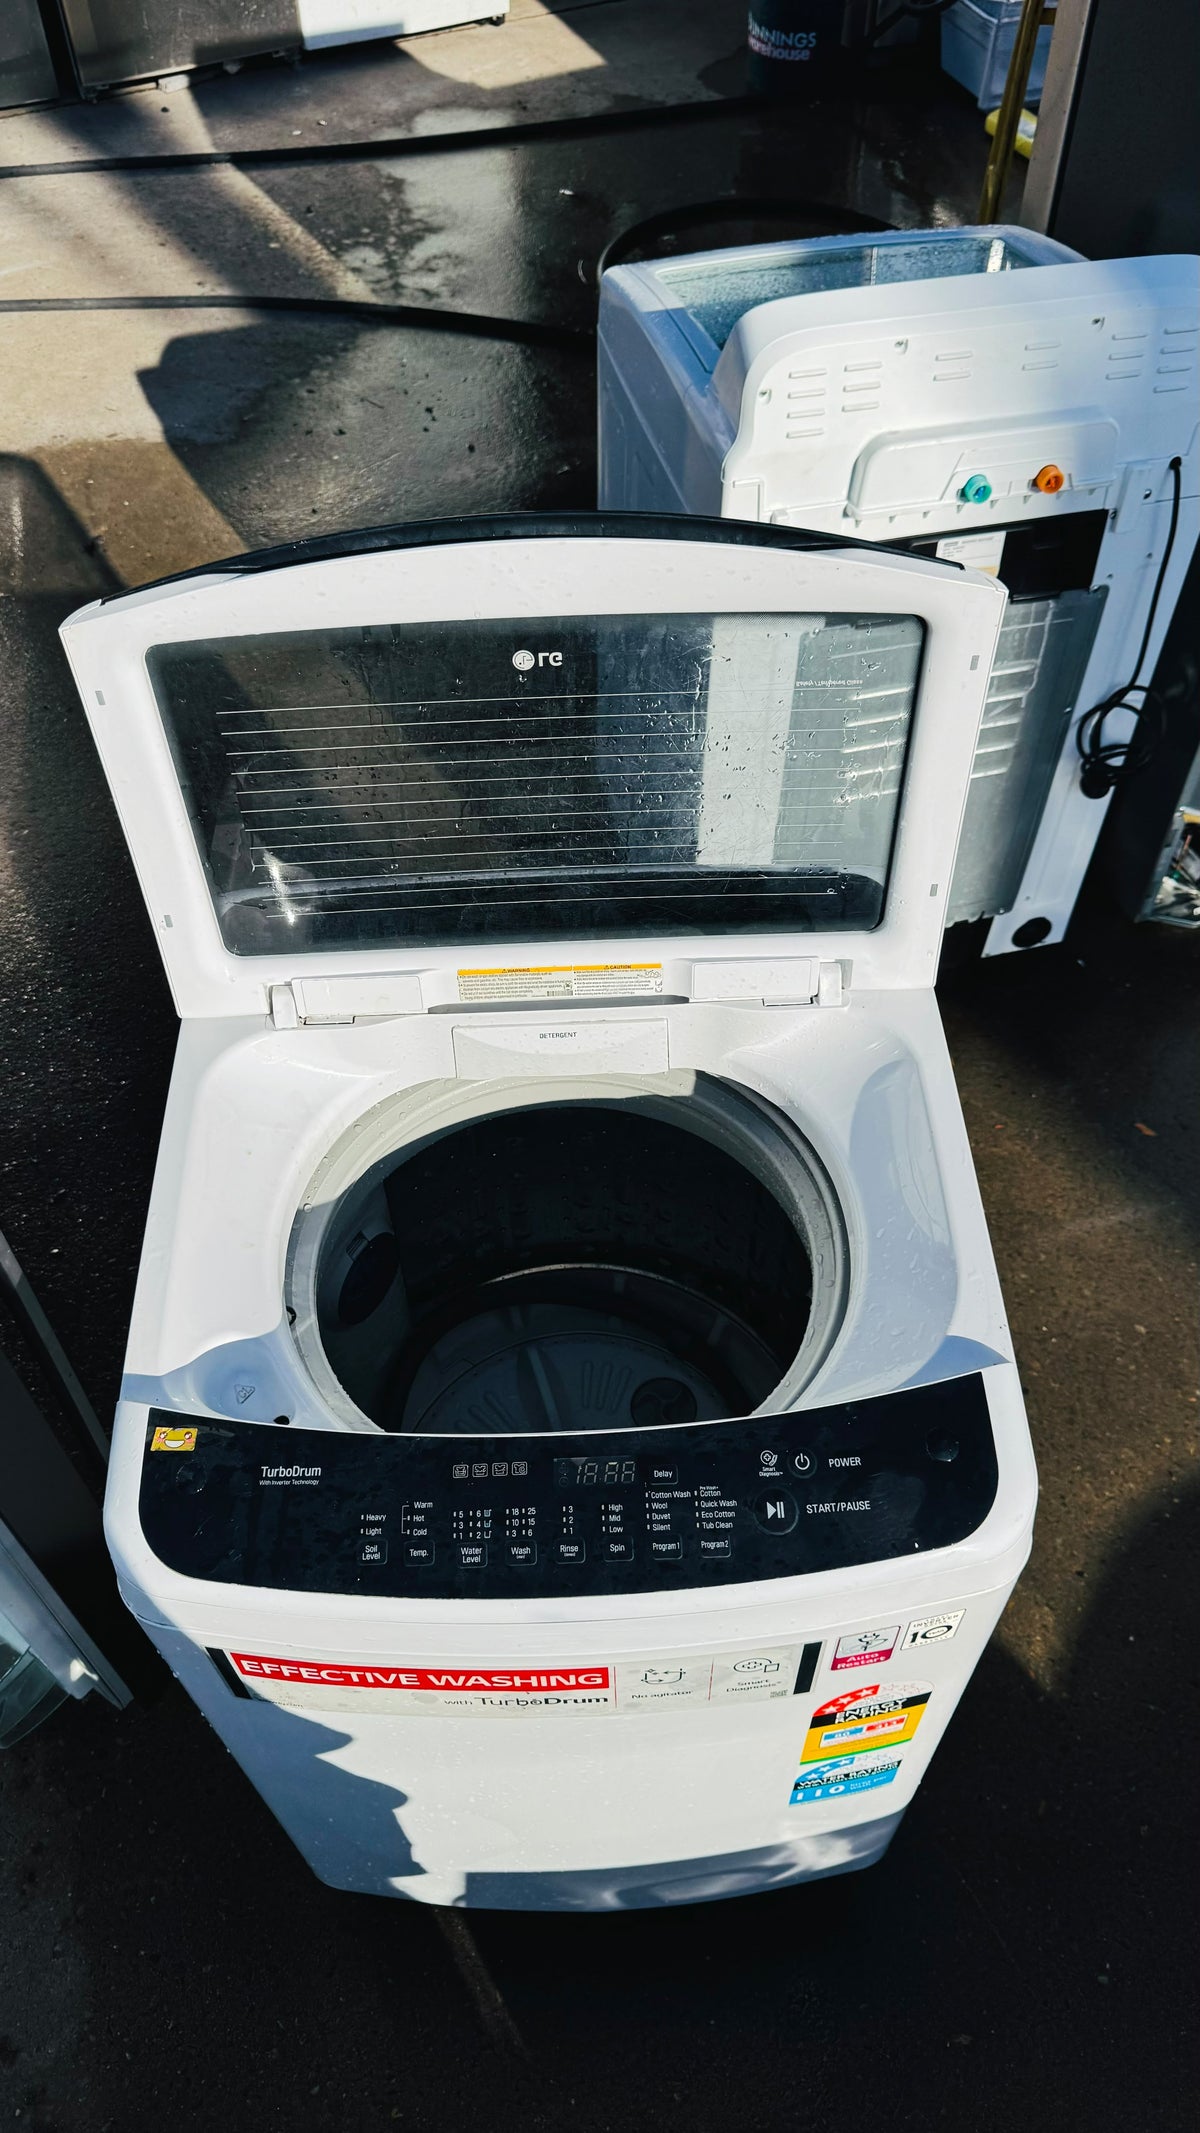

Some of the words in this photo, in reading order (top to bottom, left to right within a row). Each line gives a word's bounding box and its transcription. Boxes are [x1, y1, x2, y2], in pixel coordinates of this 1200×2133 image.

[539, 1031, 578, 1039] DETERGENT
[828, 1457, 862, 1468] POWER
[261, 1465, 322, 1478] TurboDrum
[653, 1470, 673, 1478] Delay
[699, 1489, 721, 1497] Cotton
[413, 1501, 433, 1509] Warm
[700, 1500, 718, 1508] Quick
[719, 1499, 738, 1507] Wash
[806, 1500, 871, 1514] START/PAUSE
[511, 1508, 520, 1516] 18
[527, 1507, 537, 1515] 25
[608, 1504, 623, 1512] High
[366, 1514, 387, 1522] Heavy
[413, 1514, 425, 1522] Hot
[458, 1510, 464, 1518] 5
[476, 1510, 482, 1518] 6
[651, 1512, 671, 1520] Duvet
[701, 1511, 713, 1519] Eco
[714, 1510, 736, 1518] Cotton
[527, 1518, 536, 1526] 15
[568, 1516, 574, 1524] 2
[458, 1521, 464, 1529] 3
[609, 1525, 624, 1533] Low
[652, 1523, 671, 1531] Silent
[702, 1521, 715, 1529] Tub
[715, 1521, 733, 1529] Clean
[365, 1527, 382, 1536] Light
[413, 1528, 428, 1536] Cold
[511, 1529, 517, 1537] 3
[527, 1529, 533, 1537] 6
[569, 1527, 573, 1535] 1
[459, 1532, 463, 1540] 1
[365, 1545, 378, 1553] Soil
[460, 1547, 483, 1556] Water
[511, 1547, 531, 1555] Wash
[559, 1544, 579, 1553] Rinse
[609, 1544, 626, 1553] Spin
[362, 1552, 381, 1560] Level
[409, 1549, 429, 1558] Temp.
[462, 1555, 481, 1563] Level
[846, 1653, 879, 1662] Auto
[836, 1656, 886, 1669] Restart
[240, 1659, 420, 1686] EFFECTIVE
[427, 1673, 603, 1688] WASHING
[474, 1697, 609, 1707] TurboDrum
[836, 1698, 907, 1717] ENERGY
[835, 1706, 903, 1724] RATING
[799, 1774, 845, 1787] WATER
[848, 1761, 899, 1779] RATING
